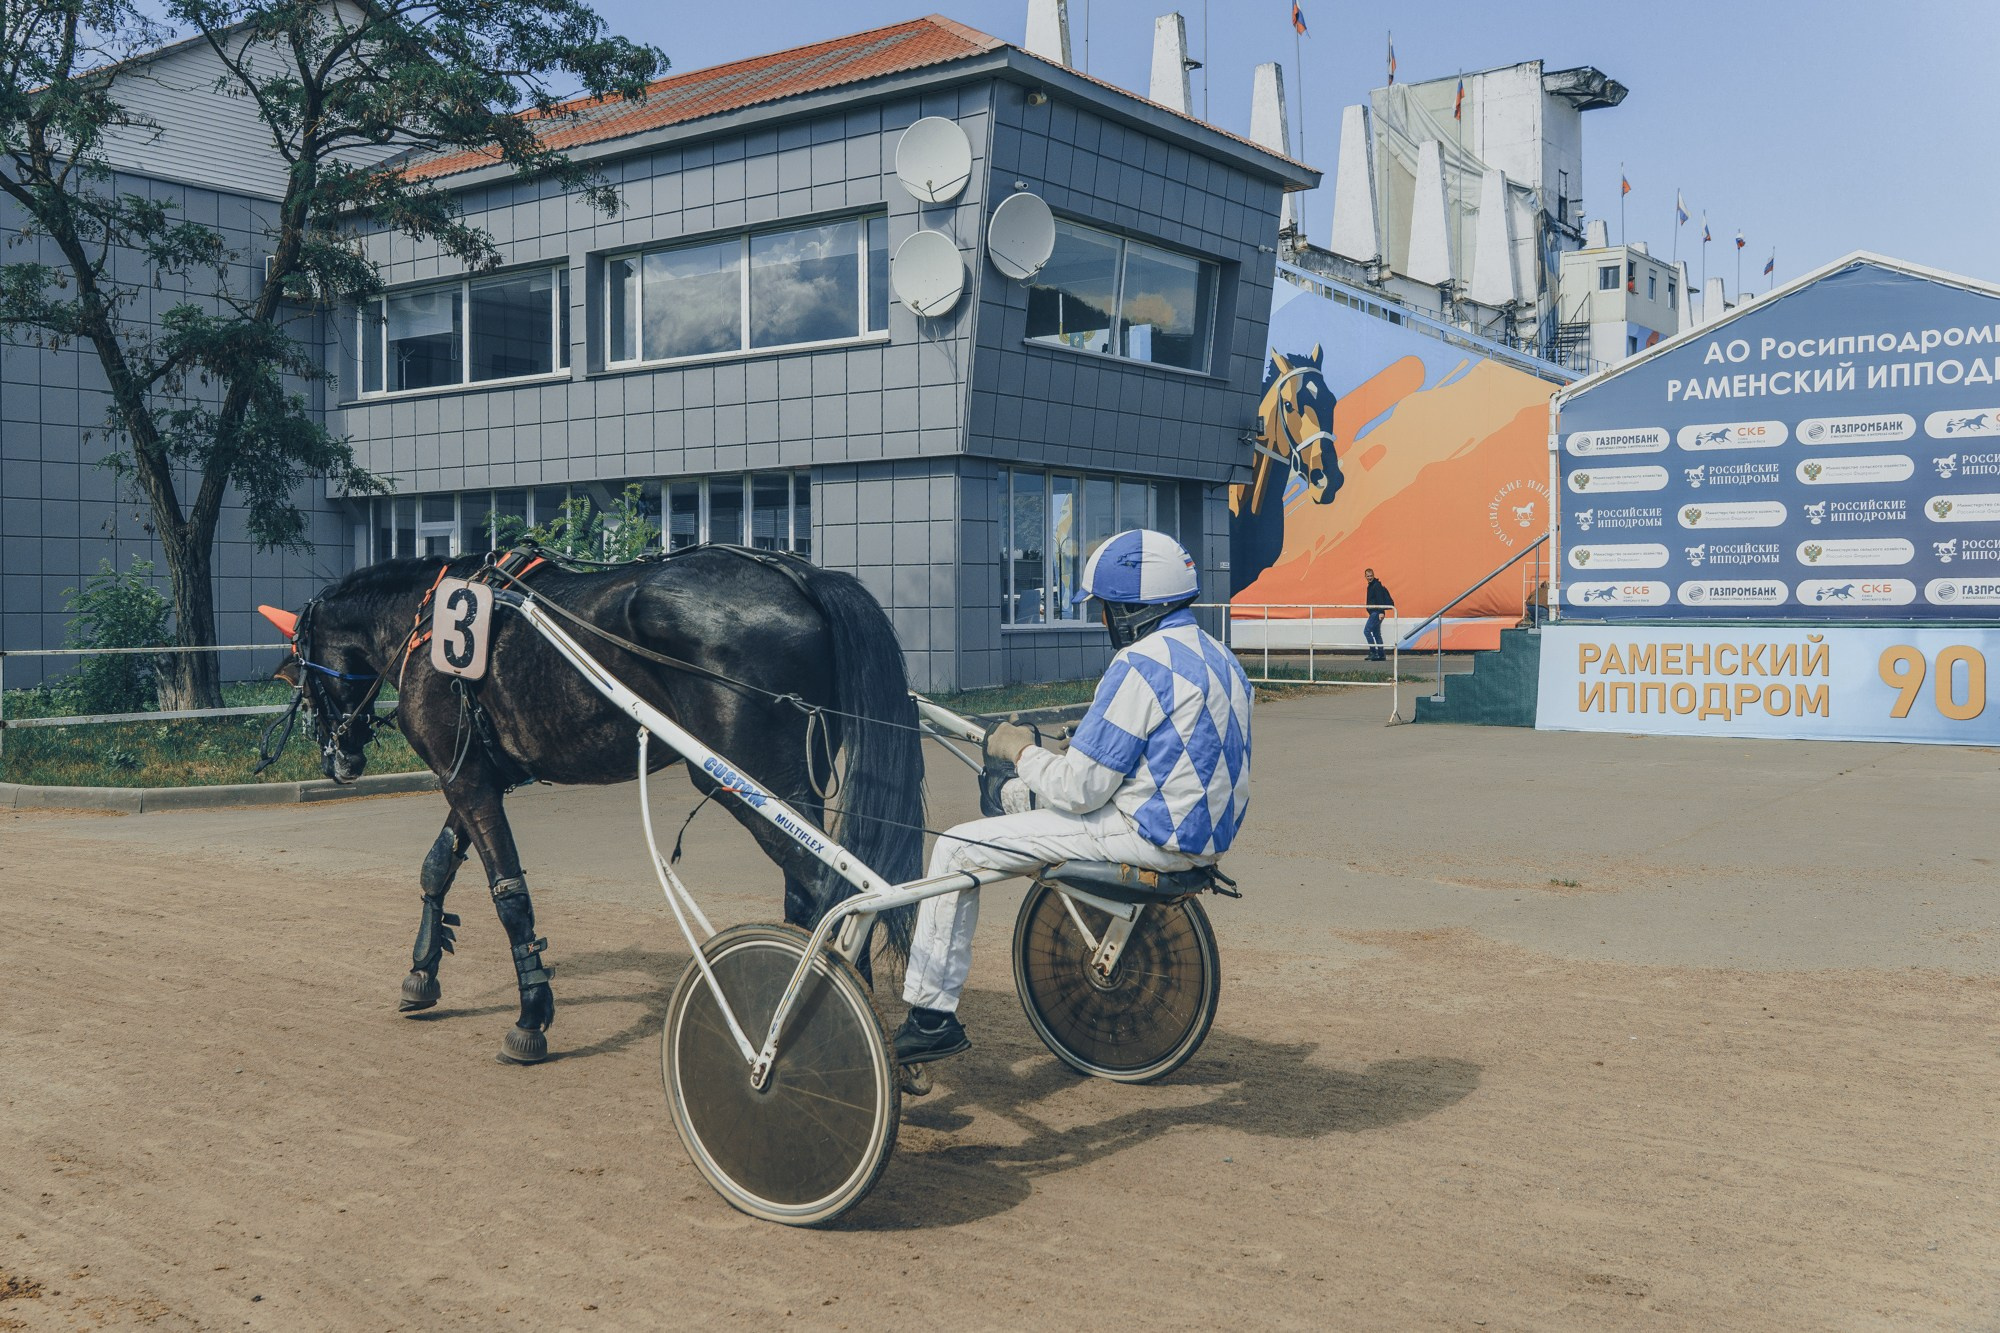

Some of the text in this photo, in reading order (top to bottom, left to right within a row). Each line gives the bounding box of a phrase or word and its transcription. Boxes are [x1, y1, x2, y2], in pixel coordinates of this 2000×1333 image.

[1703, 324, 2000, 365] АО Росипподром
[1667, 361, 1855, 401] РАМЕНСКИЙ
[1737, 426, 1766, 436] СКБ
[1830, 420, 1903, 433] ГАЗПРОМБАНК
[1596, 433, 1659, 446] ГАЗПРОМБАНК
[1709, 462, 1779, 475] РОССИЙСКИЕ
[1709, 474, 1779, 486] ИППОДРОМЫ
[1830, 499, 1906, 511] РОССИЙСКИЕ
[1597, 507, 1662, 518] РОССИЙСКИЕ
[1830, 511, 1906, 522] ИППОДРОМЫ
[1597, 517, 1662, 528] ИППОДРОМЫ
[1709, 542, 1779, 553] РОССИЙСКИЕ
[1709, 554, 1779, 565] ИППОДРОМЫ
[1623, 586, 1650, 595] СКБ
[1709, 587, 1777, 596] ГАЗПРОМБАНК
[1861, 584, 1892, 593] СКБ
[444, 588, 478, 668] 3
[1578, 634, 1830, 677] РАМЕНСКИЙ
[1878, 644, 1986, 721] 90
[1578, 681, 1830, 722] ИППОДРОМ
[703, 756, 769, 809] CUSTOM
[774, 813, 825, 854] MULTIFLEX
